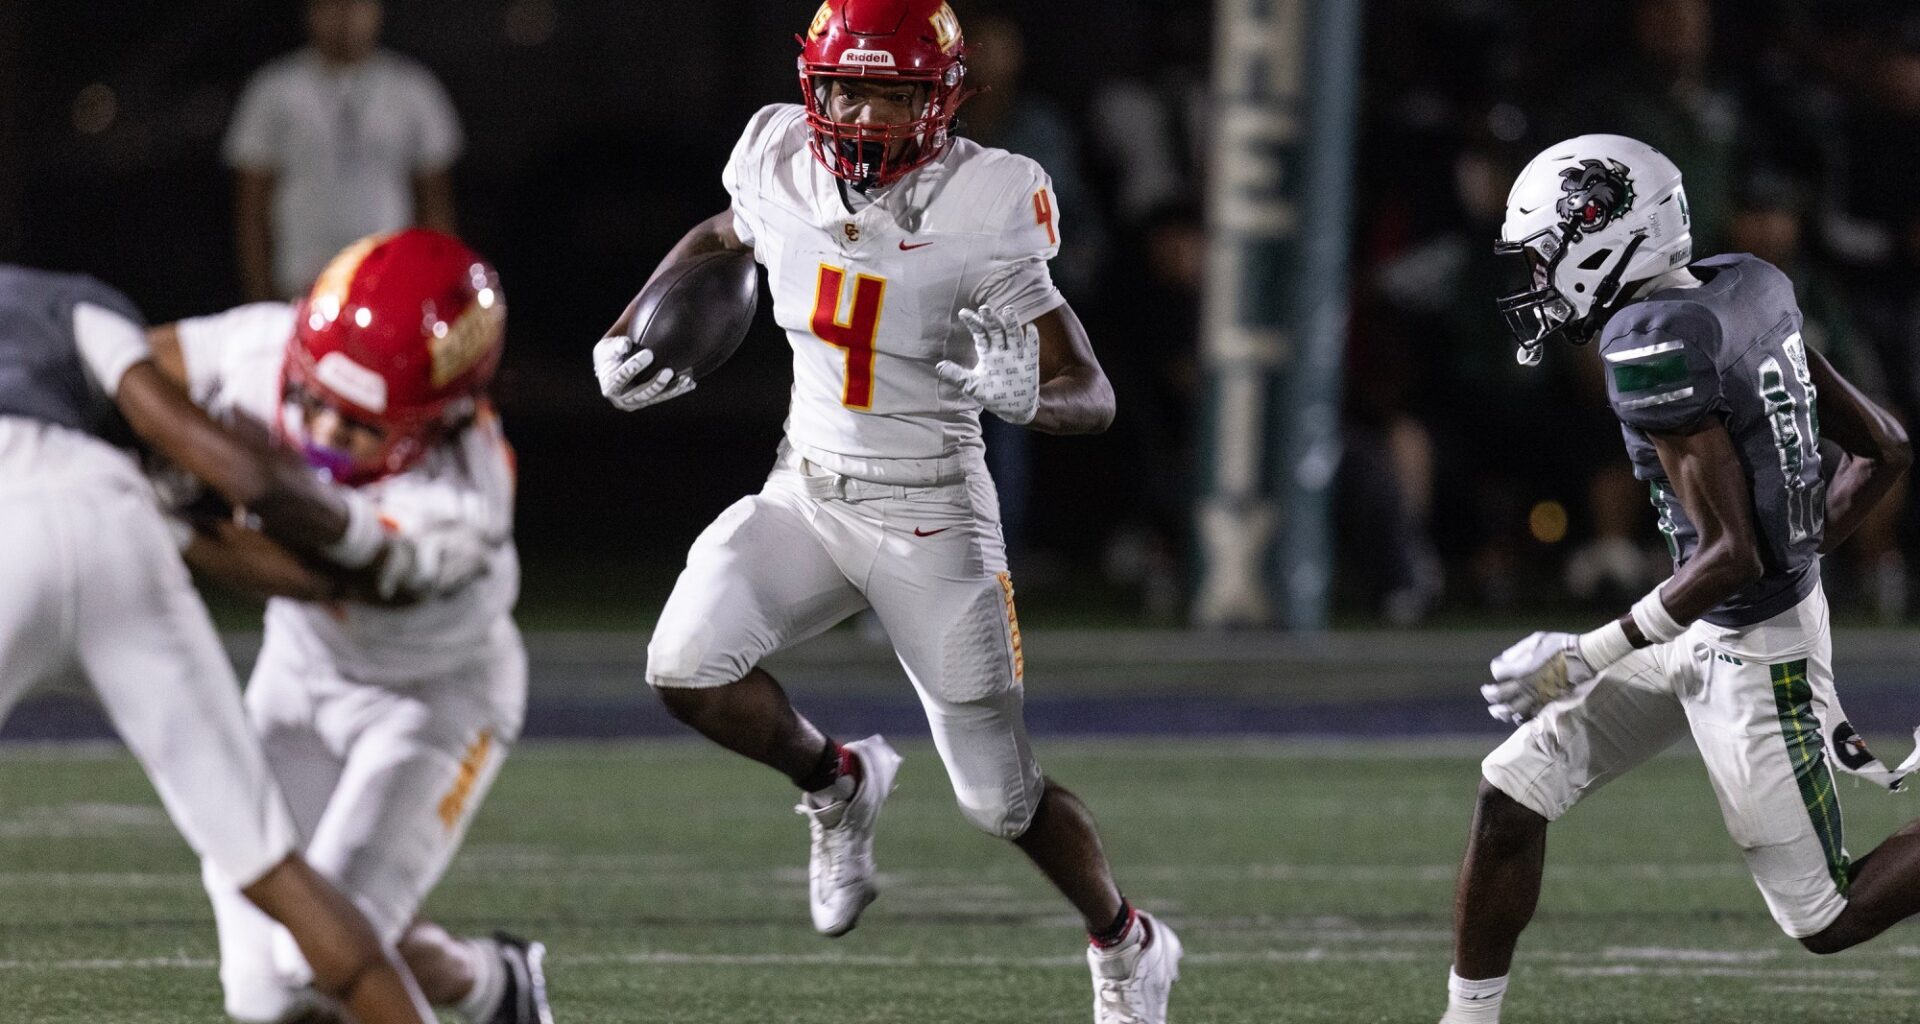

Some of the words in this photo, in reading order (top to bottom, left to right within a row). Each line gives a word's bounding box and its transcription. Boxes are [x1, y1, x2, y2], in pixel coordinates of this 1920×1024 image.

[846, 52, 888, 63] Riddell
[1033, 187, 1056, 245] 4
[810, 262, 887, 412] 4
